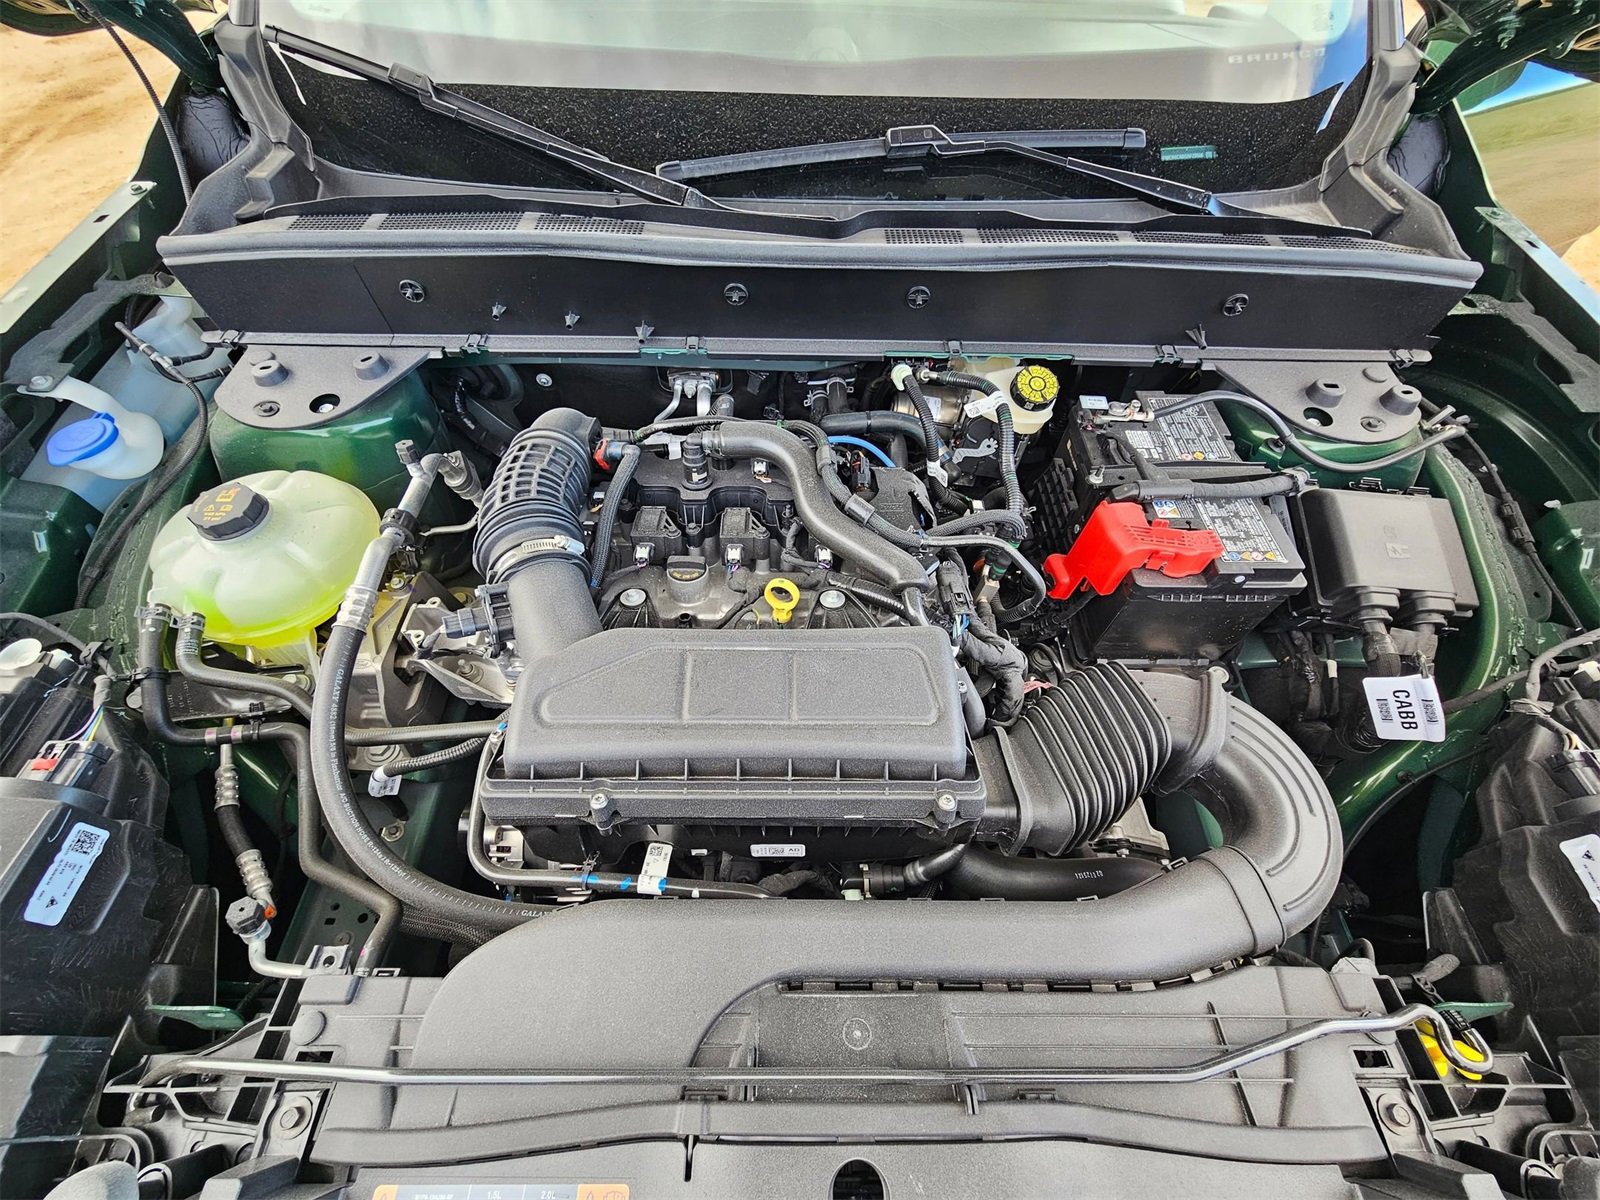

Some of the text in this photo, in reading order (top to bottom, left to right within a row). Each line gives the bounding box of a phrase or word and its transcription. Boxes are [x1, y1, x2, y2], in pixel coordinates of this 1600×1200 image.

[1393, 690, 1418, 730] CABB
[332, 668, 345, 702] GALAXY
[344, 803, 360, 828] SUCTION
[356, 826, 371, 843] HOSE
[540, 1190, 556, 1200] 2.0L
